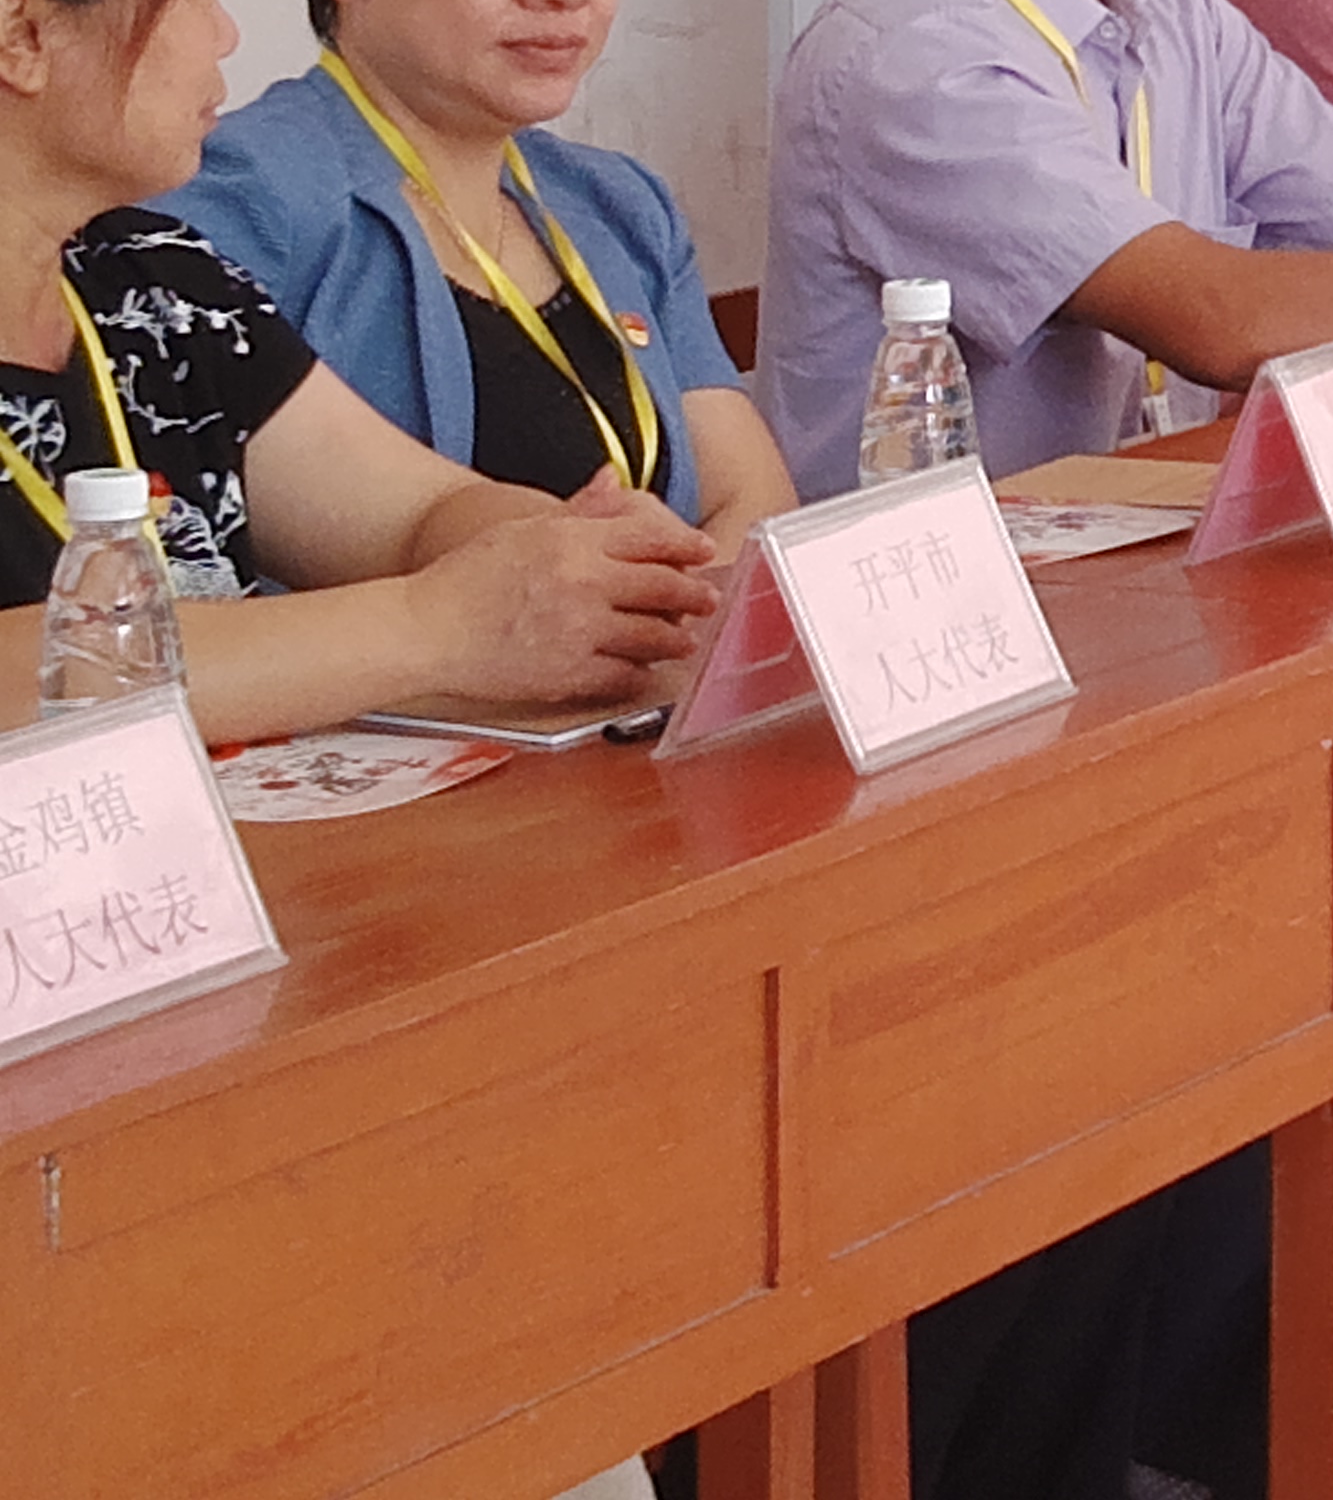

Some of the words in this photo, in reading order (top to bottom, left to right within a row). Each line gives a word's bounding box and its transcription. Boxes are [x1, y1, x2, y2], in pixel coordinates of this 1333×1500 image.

[850, 529, 961, 614] 开平市
[876, 613, 1020, 711] 人大代表
[3, 872, 209, 1008] 人大代表
